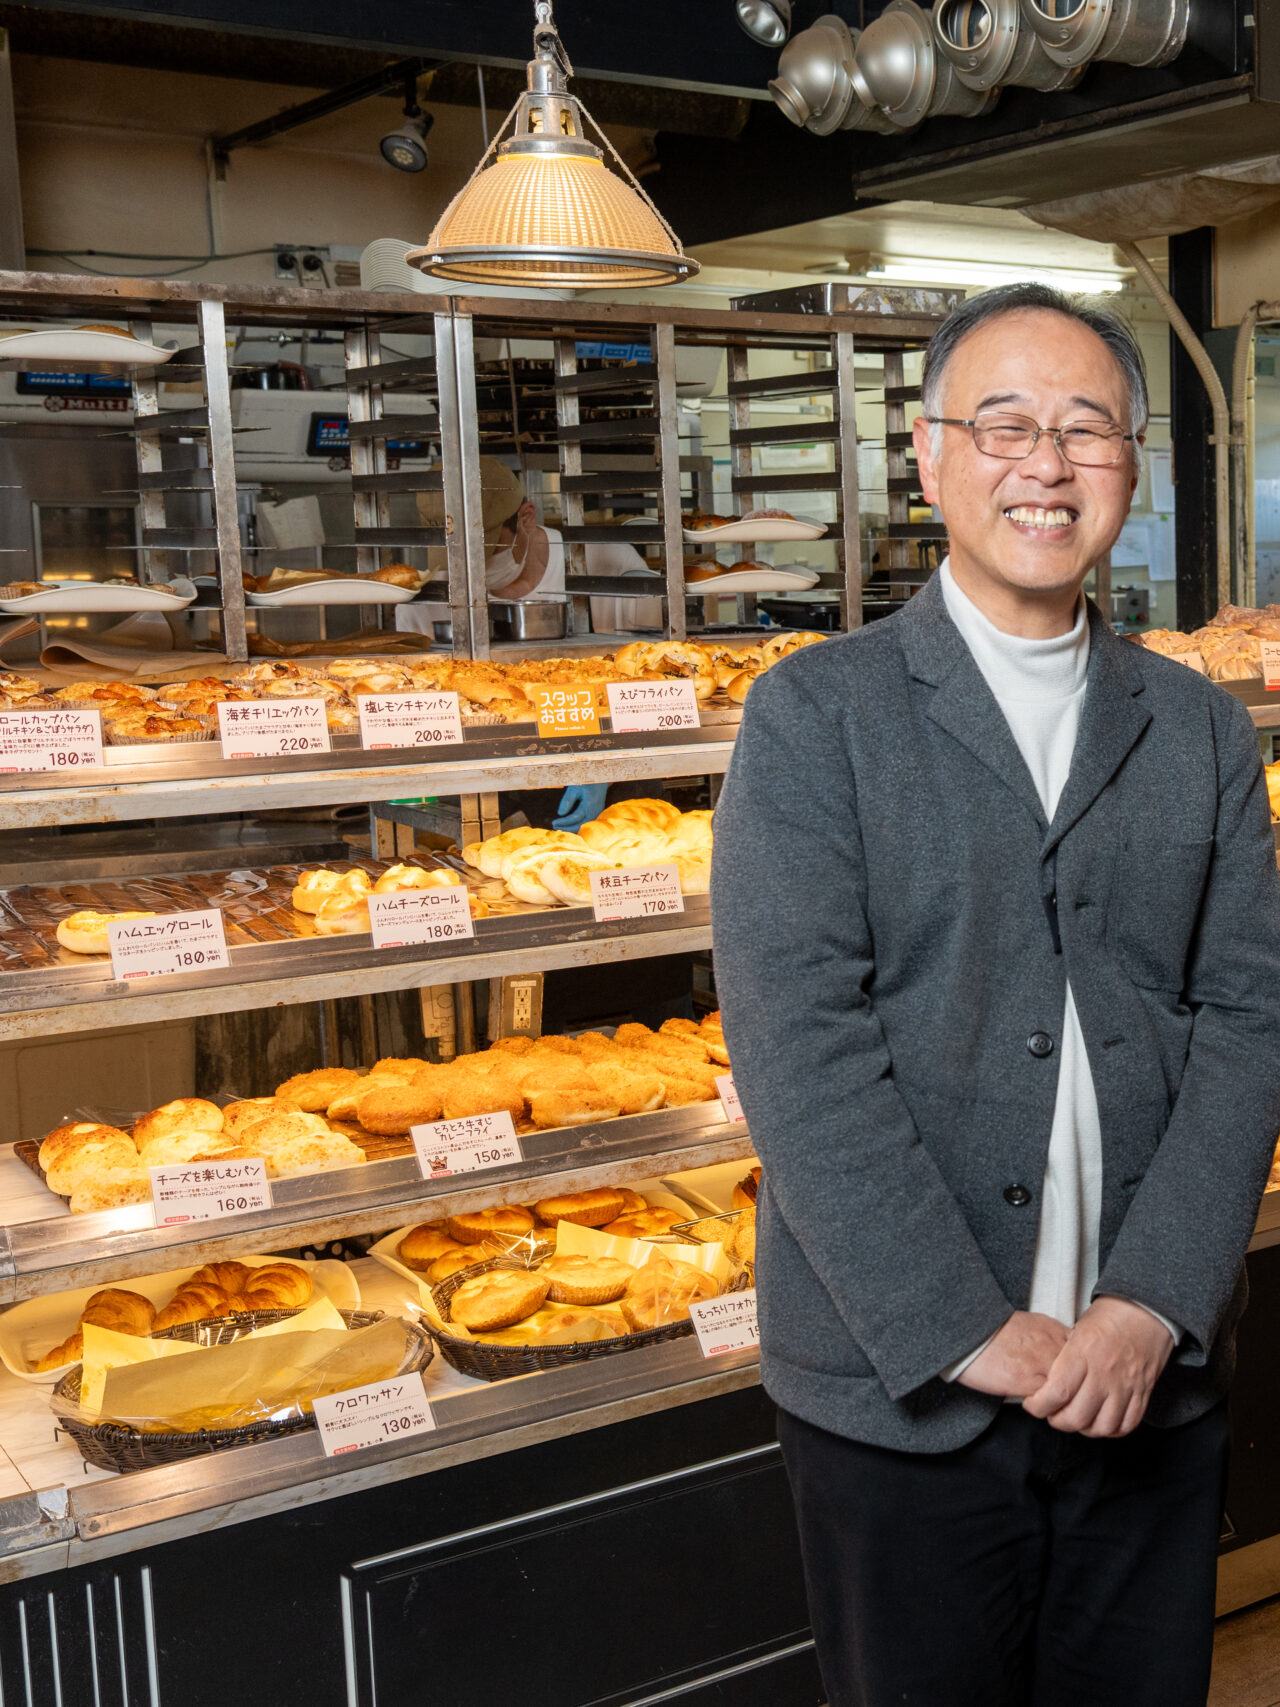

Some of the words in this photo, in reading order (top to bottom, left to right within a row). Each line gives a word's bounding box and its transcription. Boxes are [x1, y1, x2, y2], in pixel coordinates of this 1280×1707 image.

[540, 691, 591, 707] スタッフ
[619, 687, 684, 701] えびフライパン
[226, 705, 319, 721] 海老チリエッグパン
[365, 698, 452, 713] 塩レモンチキンパン
[541, 706, 595, 724] おすすめ
[658, 714, 682, 727] 200
[414, 729, 442, 742] 200
[279, 737, 309, 751] 220
[49, 752, 79, 766] 180
[599, 872, 669, 889] 枝豆チーズパン
[376, 894, 461, 911] ハムチーズロール
[643, 900, 666, 913] 170
[117, 918, 213, 939] ハムエッグロール
[426, 924, 453, 938] 180
[175, 951, 205, 967] 180
[206, 954, 221, 962] yen
[433, 1117, 493, 1134] とろとろ牛すじ
[439, 1126, 489, 1141] カレーフライ
[474, 1149, 500, 1164] 150
[157, 1165, 261, 1186] チーズを楽しむパン
[217, 1197, 247, 1212] 160
[335, 1386, 404, 1413] クロワッサン
[381, 1416, 411, 1435] 130
[413, 1418, 426, 1427] yen
